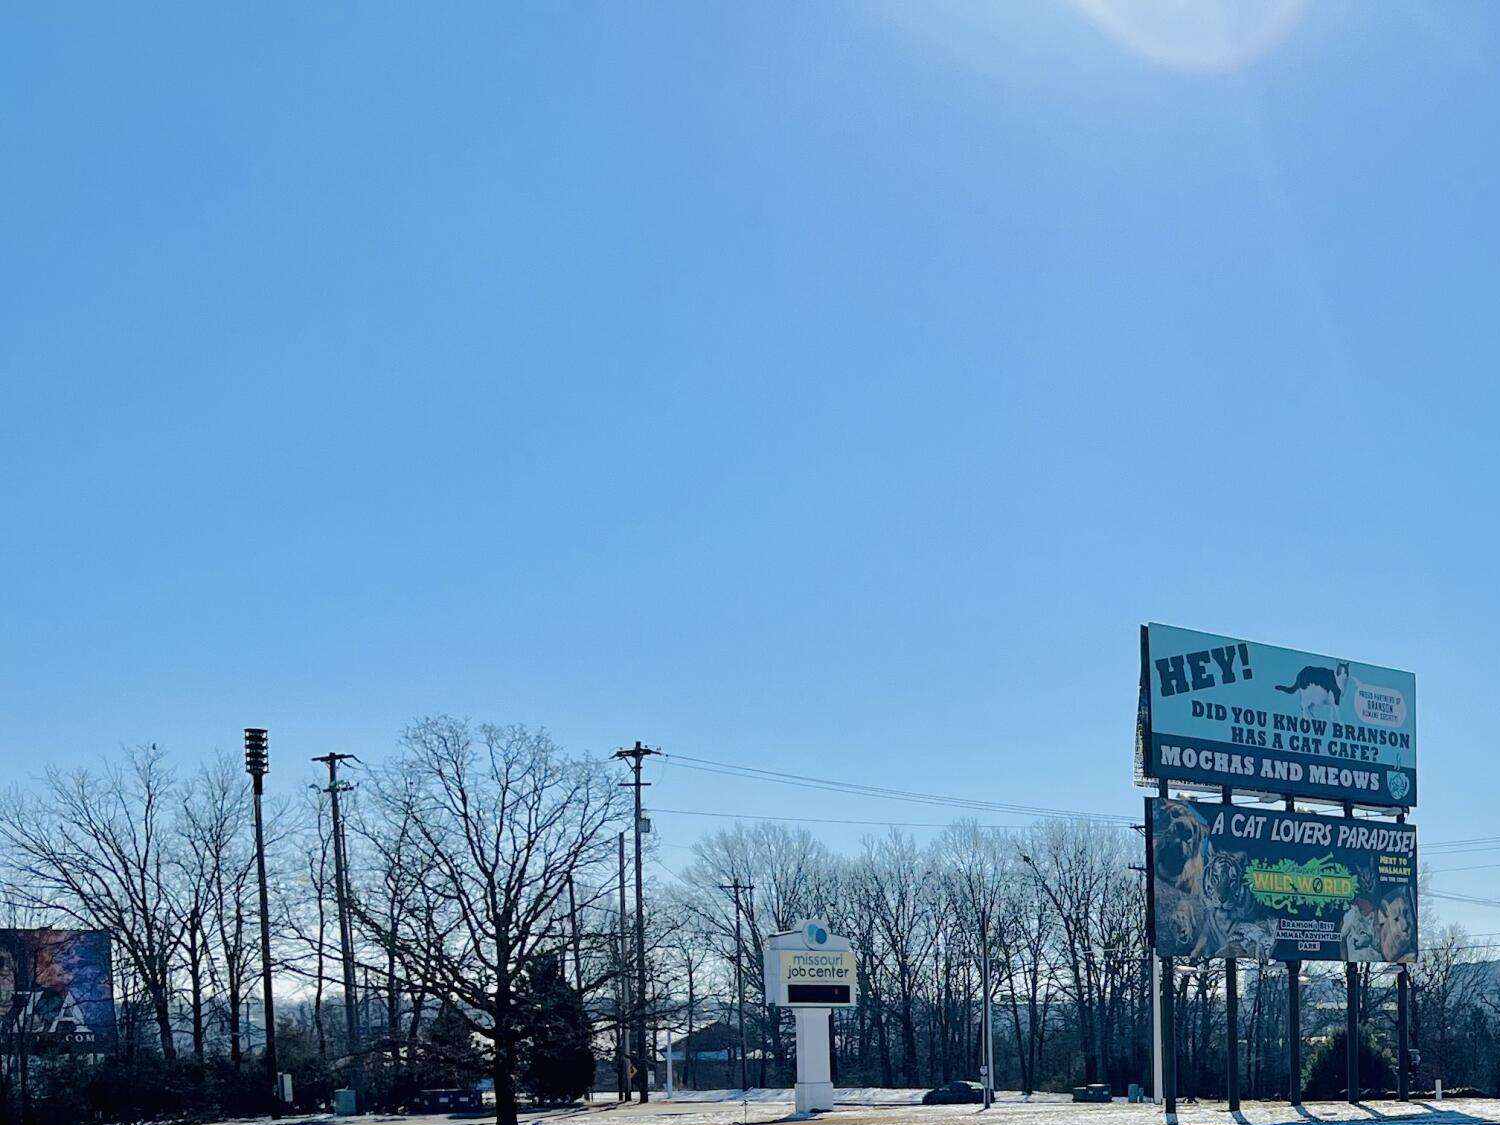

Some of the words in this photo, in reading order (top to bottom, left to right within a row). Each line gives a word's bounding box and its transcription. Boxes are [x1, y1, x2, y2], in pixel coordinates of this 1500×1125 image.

[1155, 643, 1253, 697] HEY!
[1192, 700, 1227, 721] DID
[1231, 706, 1267, 727] YOU
[1273, 713, 1327, 736] KNOW
[1332, 722, 1410, 749] BRANSON
[1231, 726, 1267, 747] HAS
[1272, 732, 1284, 749] A
[1289, 735, 1322, 754] CAT
[1327, 740, 1379, 761] CAFE?
[1160, 745, 1255, 776] MOCHAS
[1260, 758, 1303, 781] AND
[1309, 764, 1380, 791] MEOWS
[1211, 812, 1224, 835] A
[1231, 813, 1267, 839] CAT
[1271, 818, 1333, 847] LOVERS
[1337, 825, 1415, 858] PARADISE!
[1379, 866, 1411, 876] WALMART
[1380, 855, 1397, 865] NEXT
[1398, 857, 1408, 866] TO
[1254, 871, 1294, 892] WILD
[1297, 876, 1351, 898] WORLD
[793, 953, 843, 966] missouri
